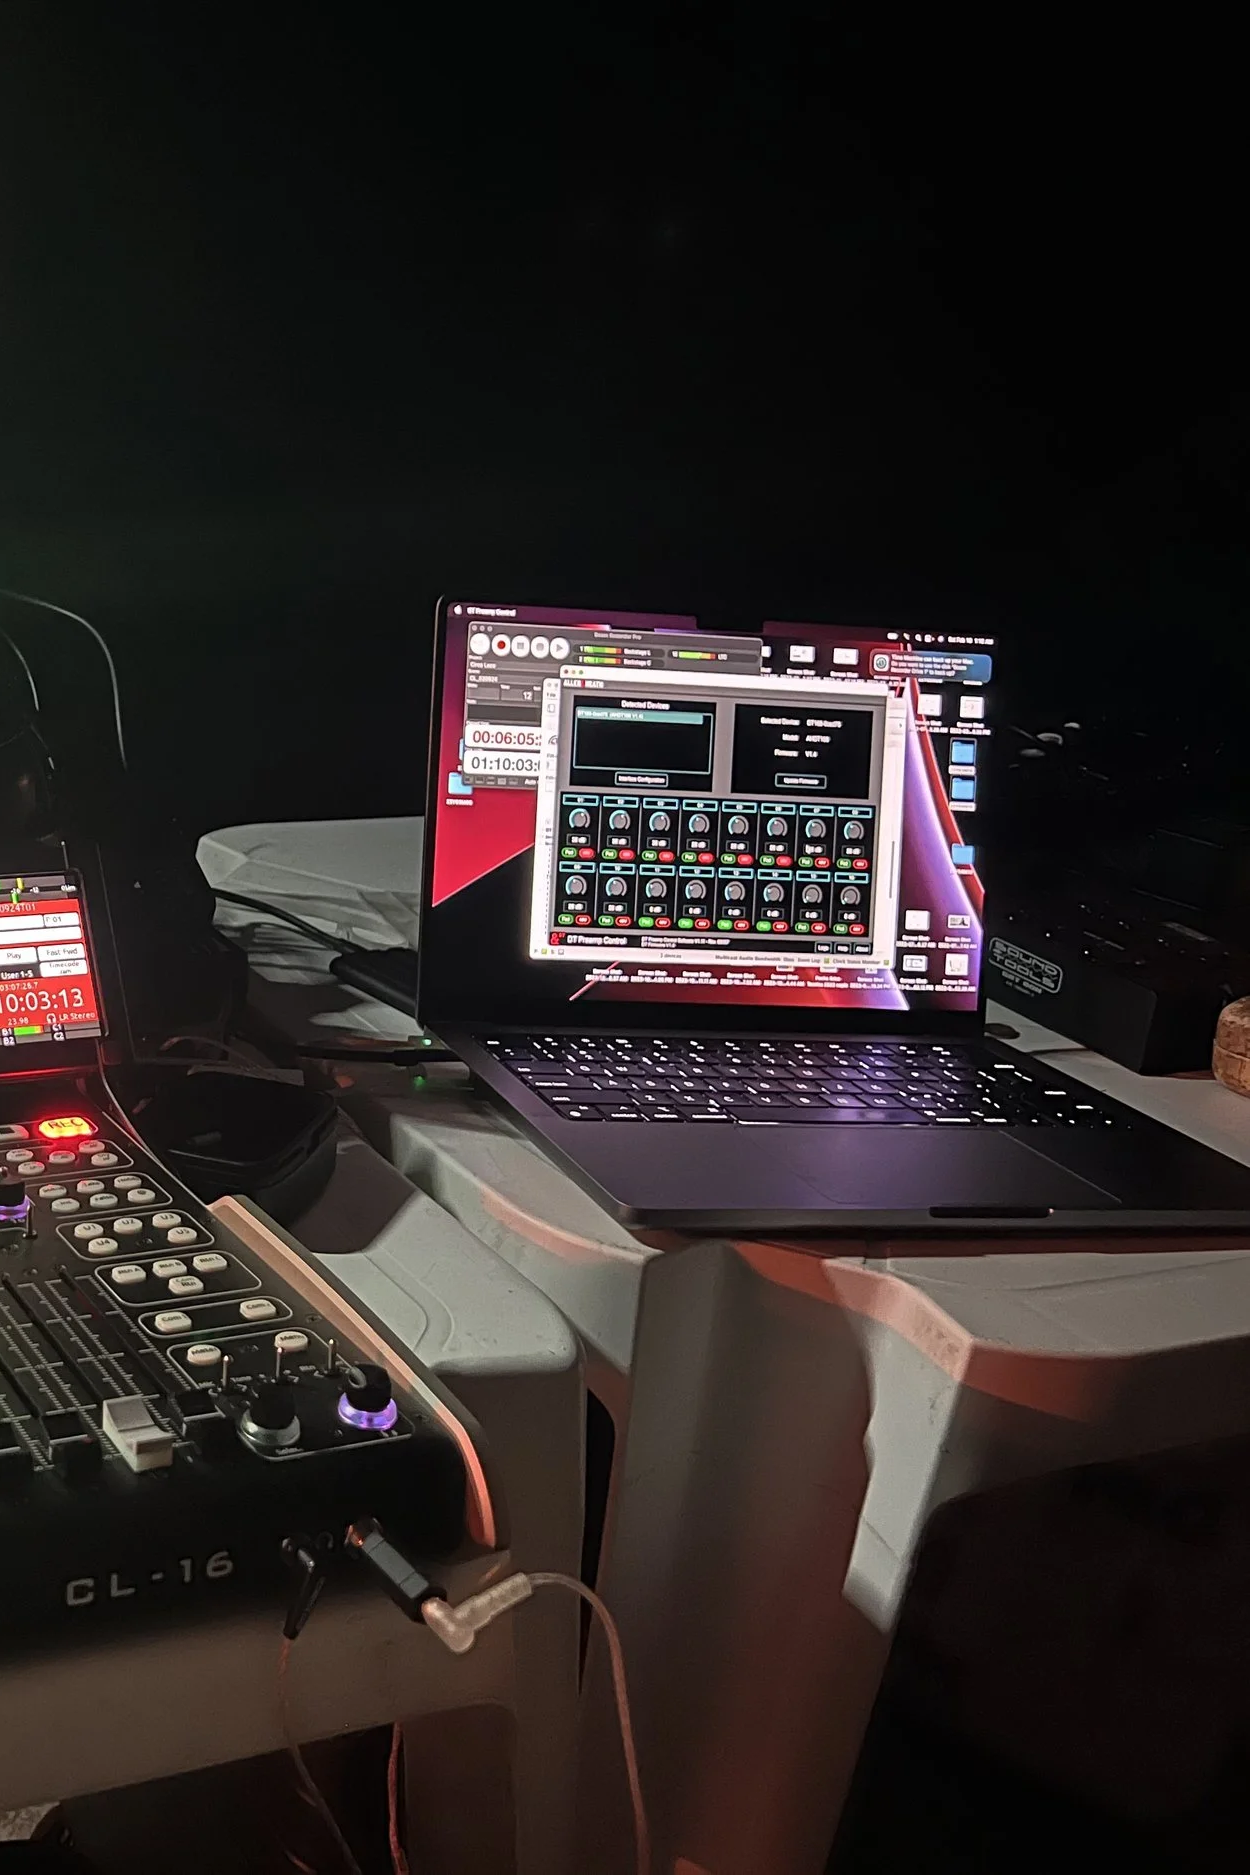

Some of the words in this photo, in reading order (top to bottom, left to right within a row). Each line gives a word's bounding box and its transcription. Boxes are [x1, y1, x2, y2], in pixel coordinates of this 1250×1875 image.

[523, 691, 532, 700] 12
[472, 756, 540, 772] 01:10:03:
[604, 936, 627, 946] Control
[7, 952, 22, 961] Play
[993, 941, 1058, 975] SOUND
[993, 953, 1055, 988] TOOLS
[0, 972, 19, 980] User
[70, 1012, 96, 1020] Stereo
[7, 1017, 29, 1026] 23.98
[2, 1028, 13, 1036] B1
[53, 1032, 64, 1040] C2
[3, 1037, 15, 1045] B2
[48, 1118, 84, 1130] REC
